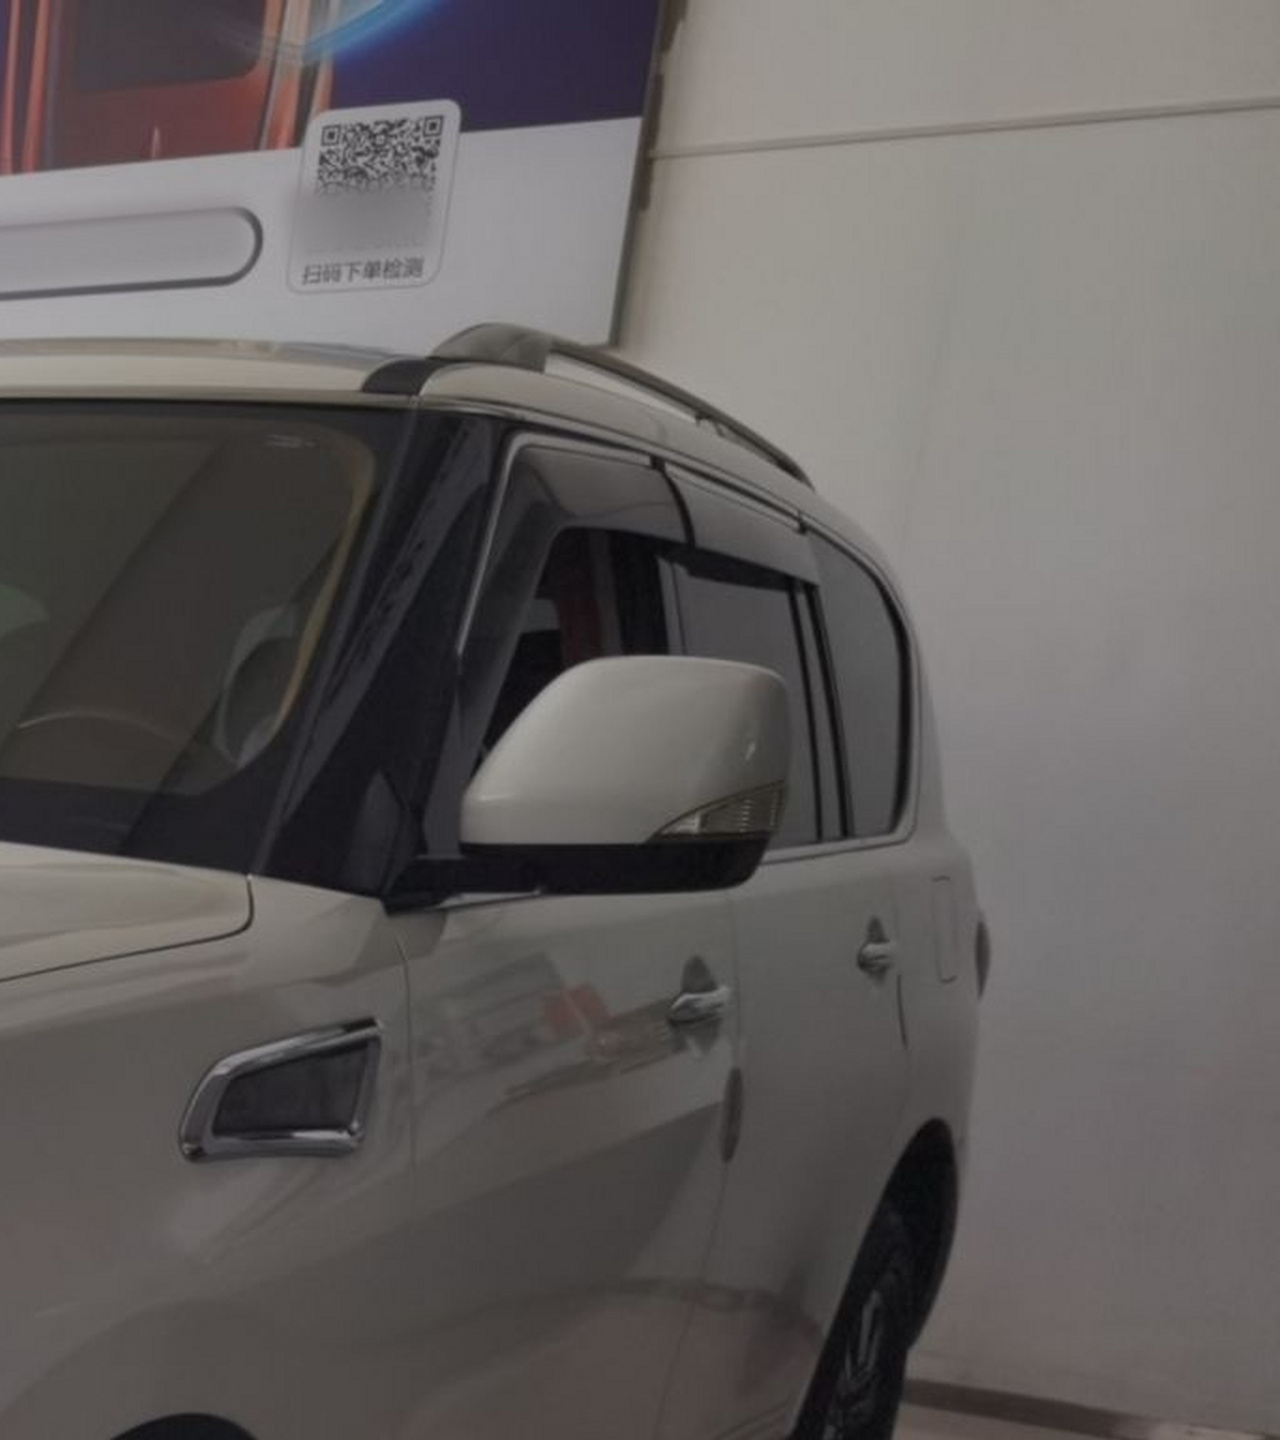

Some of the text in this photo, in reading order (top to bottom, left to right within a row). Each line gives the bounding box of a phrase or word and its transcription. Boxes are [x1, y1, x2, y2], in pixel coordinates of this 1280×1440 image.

[302, 256, 425, 285] 扫码下单检测
